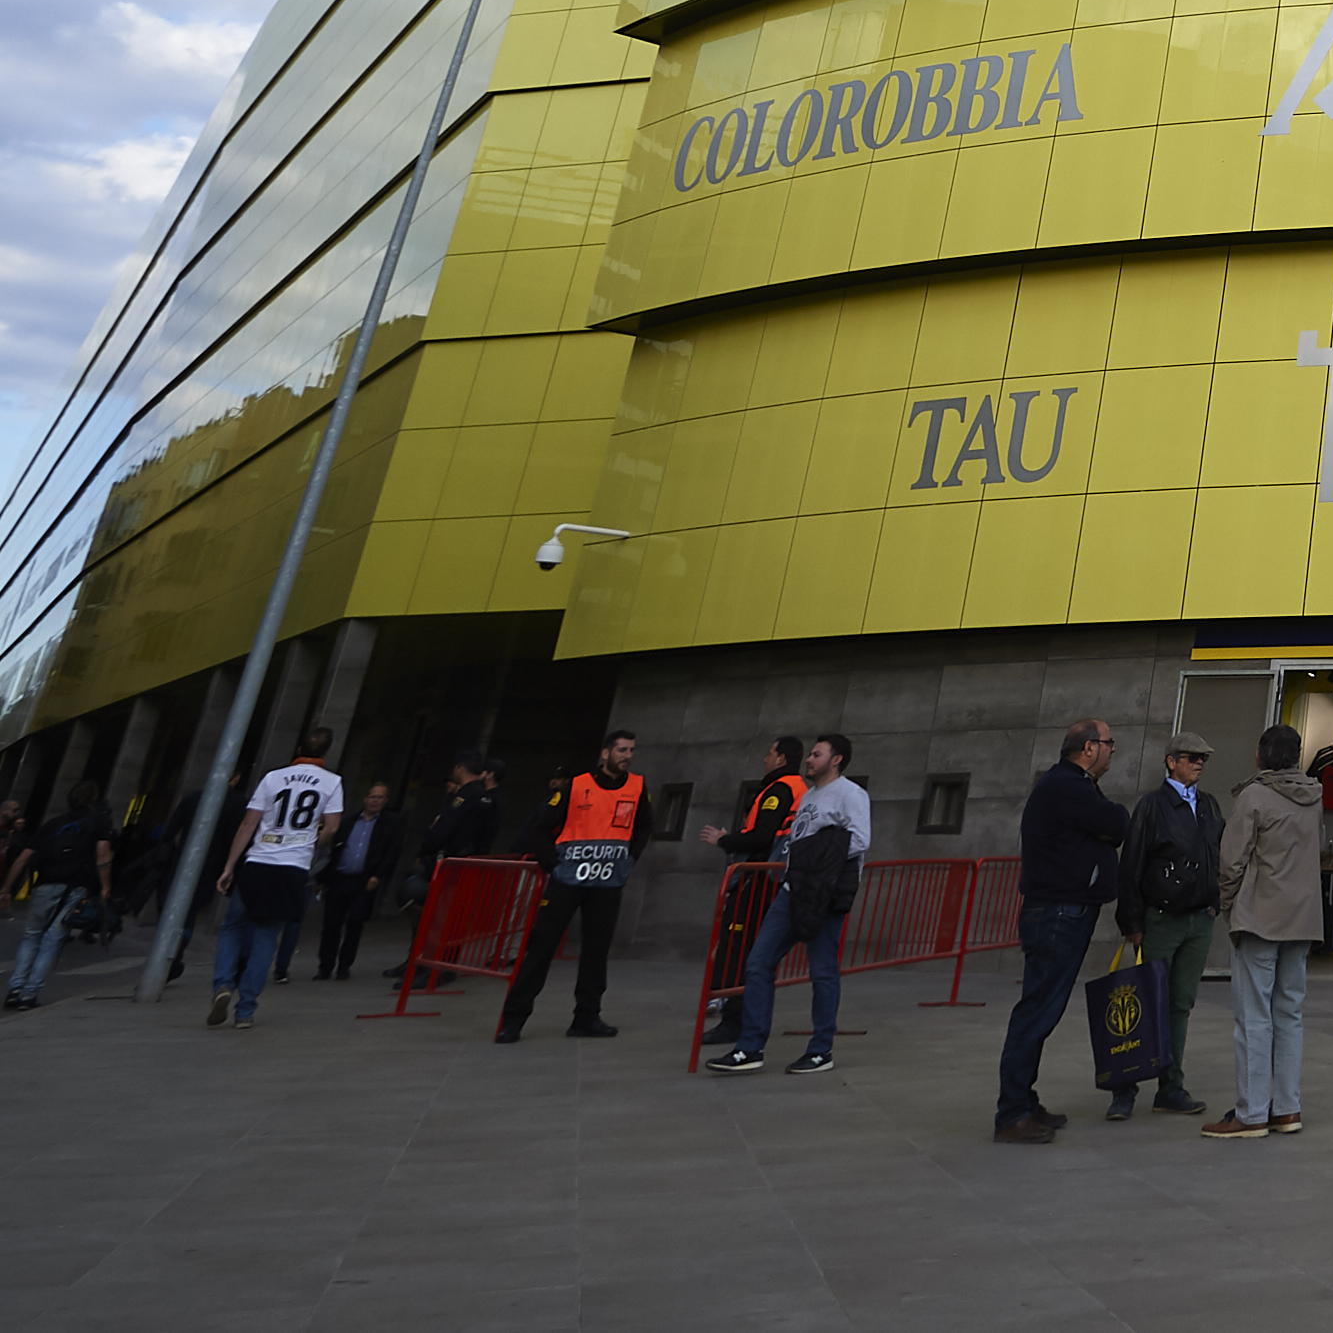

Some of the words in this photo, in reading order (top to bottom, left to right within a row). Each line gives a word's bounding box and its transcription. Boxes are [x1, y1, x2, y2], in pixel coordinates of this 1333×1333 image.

[673, 42, 1085, 193] COLOROBBIA
[907, 386, 1079, 491] TAU
[283, 773, 321, 787] JAVIER
[272, 787, 321, 830] 18
[575, 862, 615, 882] 096
